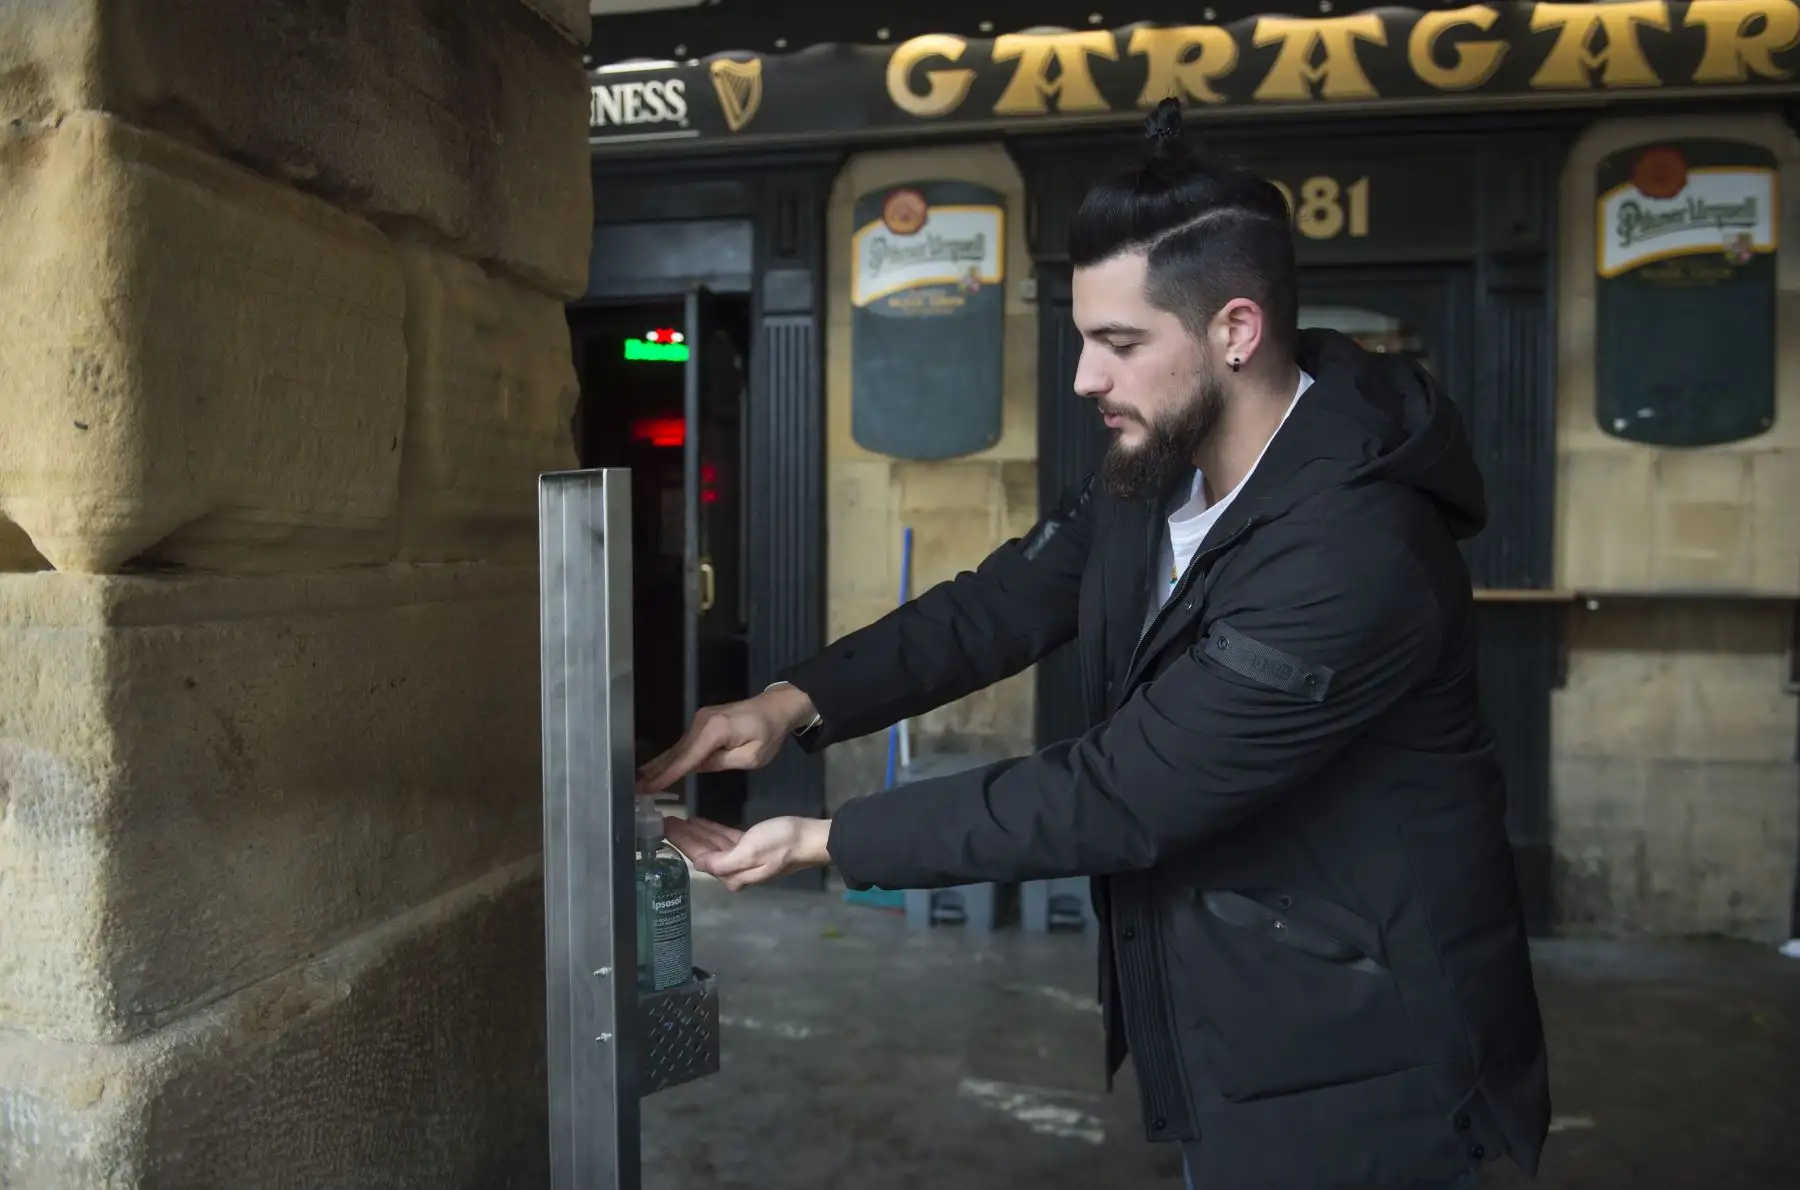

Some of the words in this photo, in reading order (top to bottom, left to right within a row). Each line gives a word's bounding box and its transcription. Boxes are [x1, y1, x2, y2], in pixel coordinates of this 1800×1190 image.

[886, 0, 1800, 118] GARAGAR
[590, 78, 687, 126] NESS
[1266, 175, 1369, 239] 81
[652, 895, 682, 912] Ipsosol
